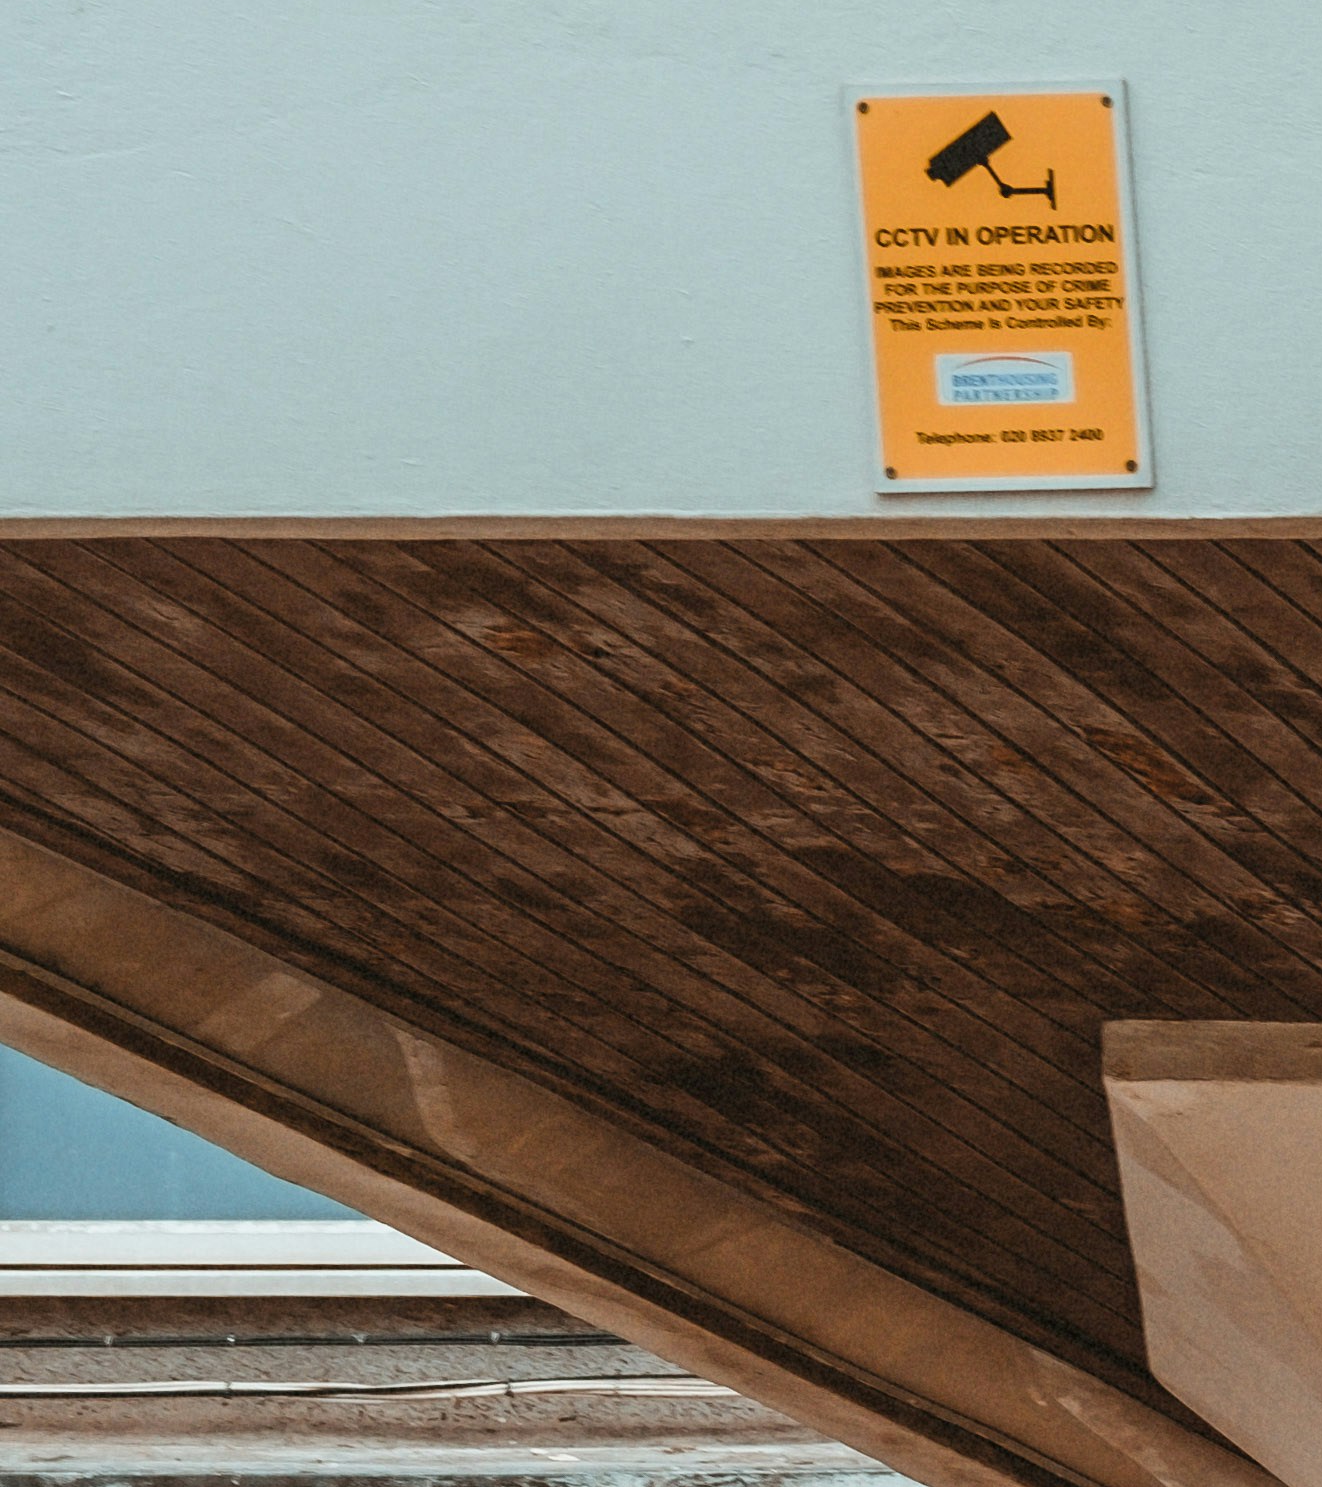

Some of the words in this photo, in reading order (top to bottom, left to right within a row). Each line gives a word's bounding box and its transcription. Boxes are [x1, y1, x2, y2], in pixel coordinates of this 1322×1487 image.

[875, 228, 939, 247] CCTV
[945, 227, 970, 245] IN
[976, 224, 1115, 245] OPERATION
[875, 265, 936, 278] IMAGES
[941, 264, 972, 277] ARE
[976, 263, 1025, 277] BEING
[1029, 261, 1118, 275] RECORDED
[884, 283, 918, 296] FOR
[921, 282, 952, 295] THE
[956, 281, 1032, 294] PURPOSE
[1035, 280, 1057, 293] OF
[1061, 279, 1111, 292] CRIME
[873, 300, 974, 314] PREVENTION
[978, 299, 1012, 312] AND
[1014, 298, 1060, 311] YOUR
[1063, 296, 1124, 310] SAFETY
[889, 318, 921, 331] This
[926, 317, 983, 330] Scheme
[1006, 315, 1083, 329] Controlled
[915, 431, 997, 447] Telephone:
[1001, 429, 1027, 442] 020
